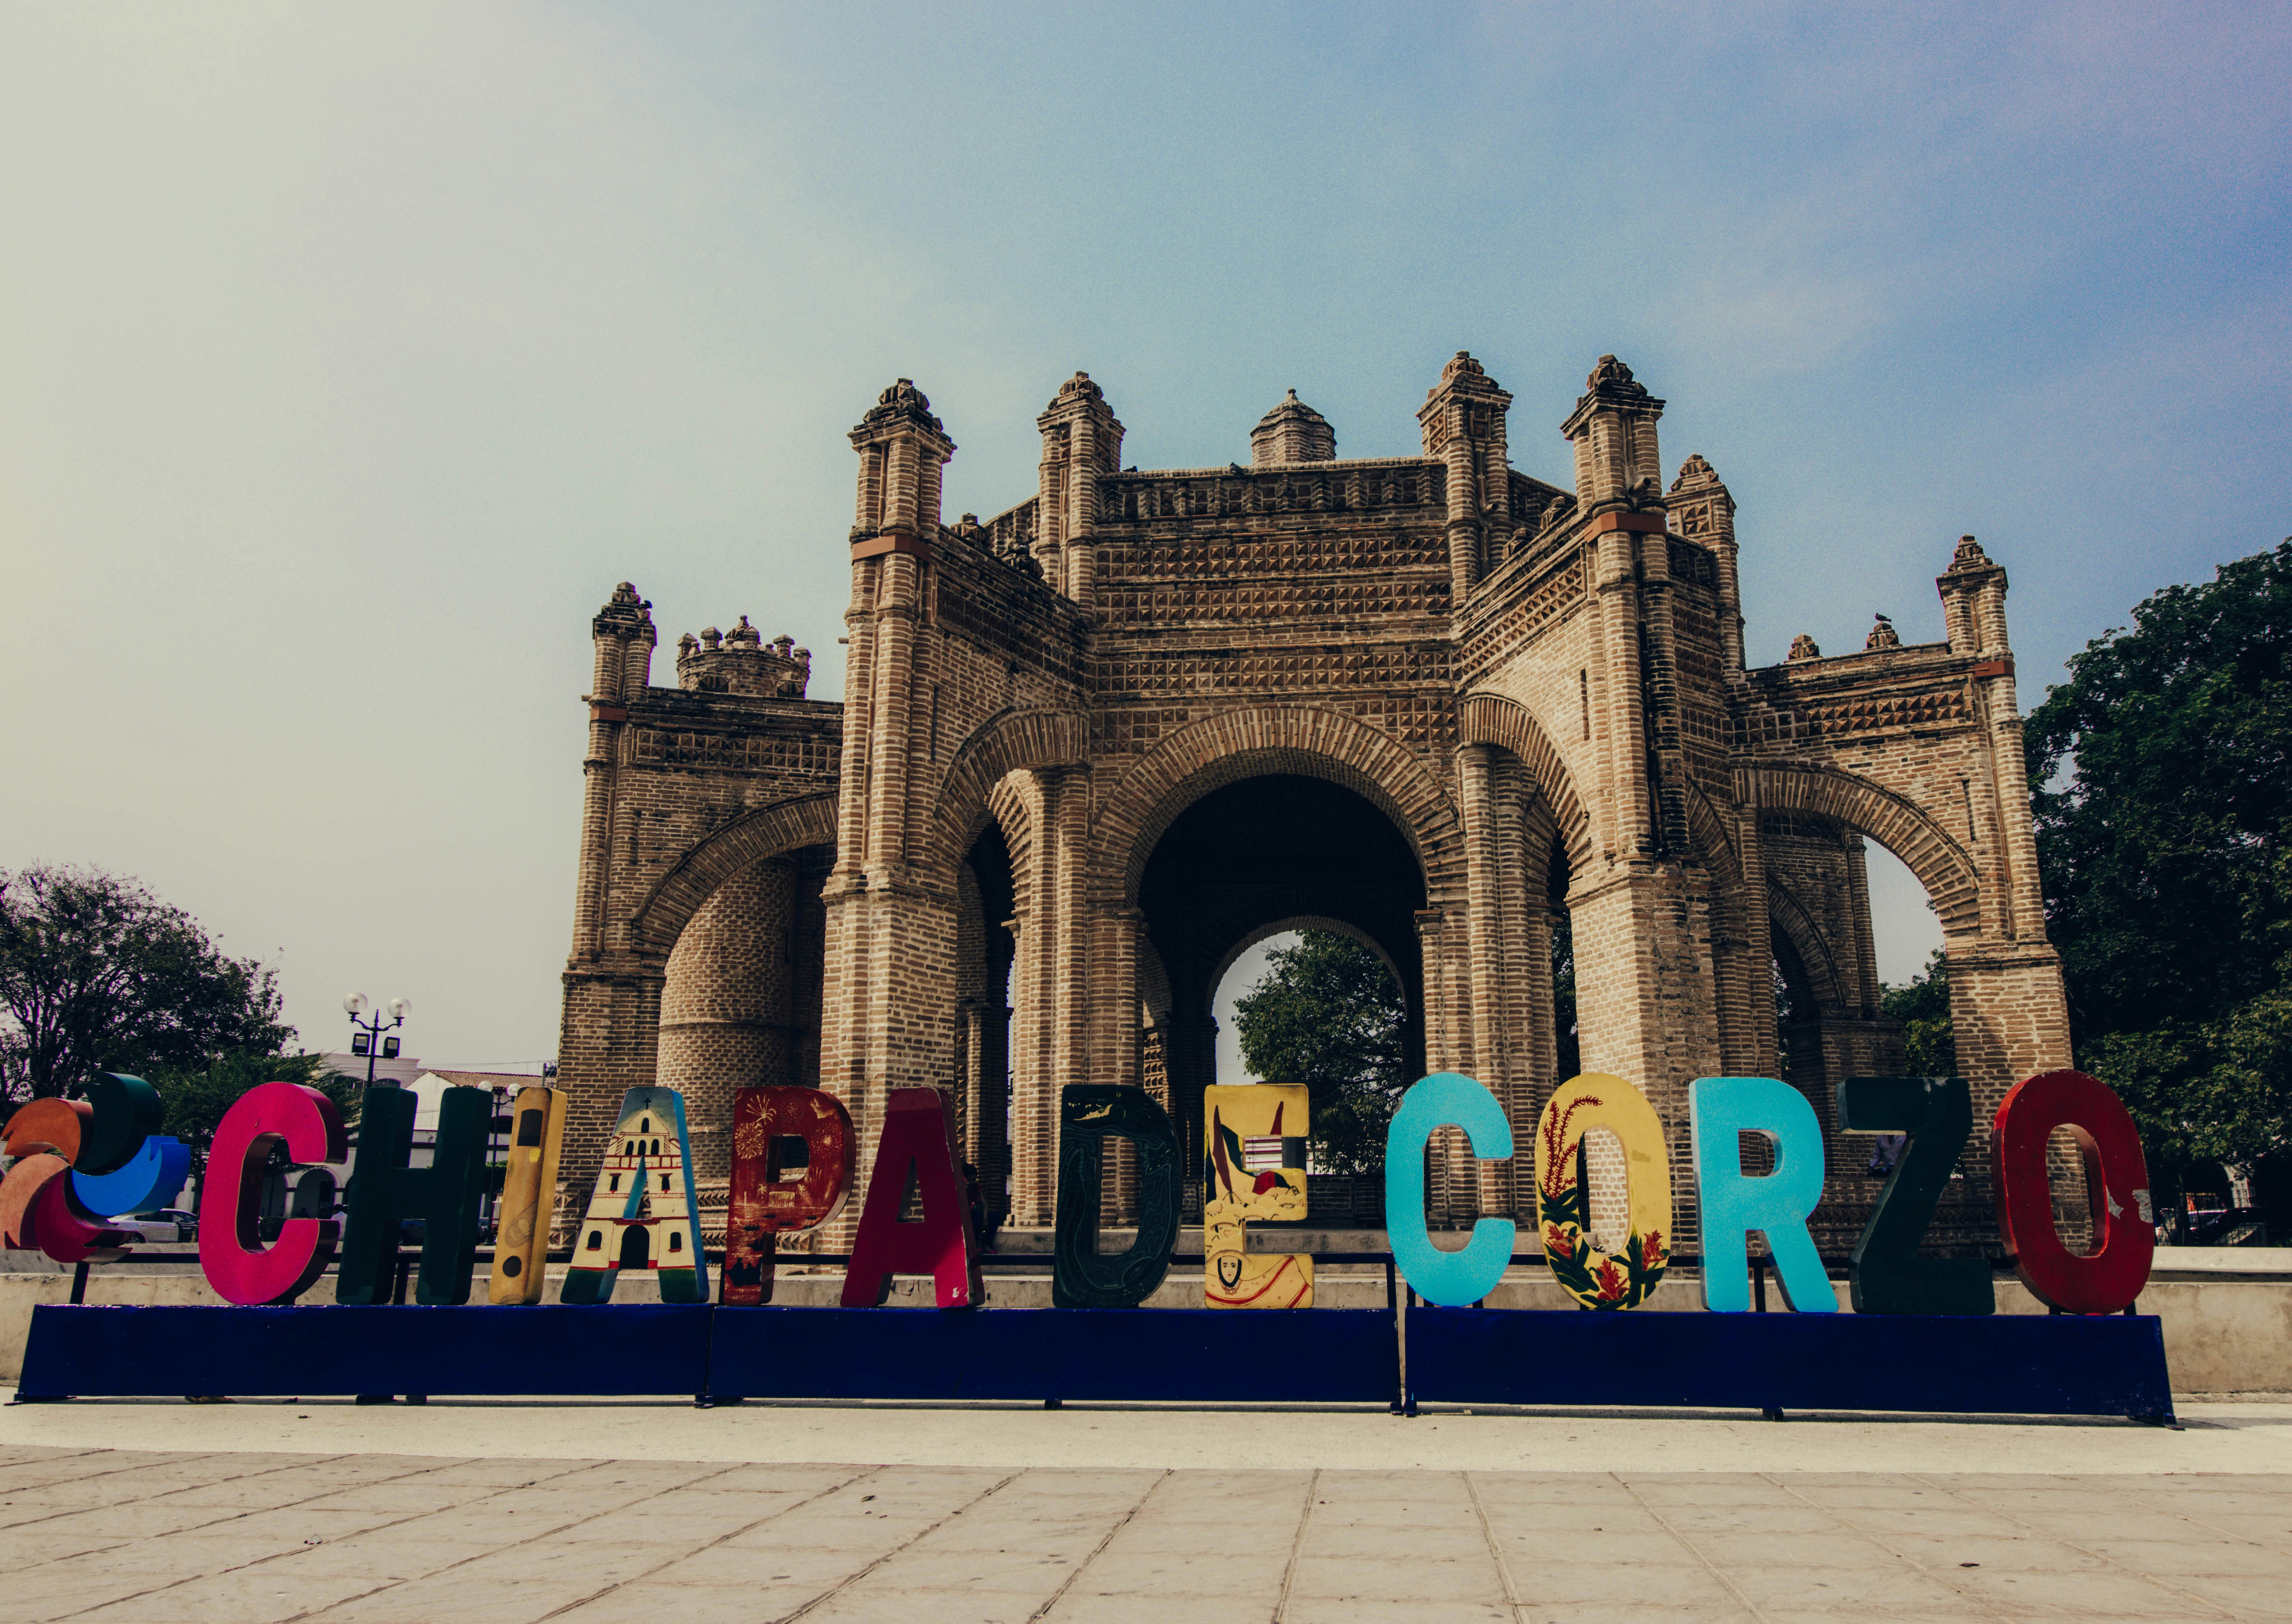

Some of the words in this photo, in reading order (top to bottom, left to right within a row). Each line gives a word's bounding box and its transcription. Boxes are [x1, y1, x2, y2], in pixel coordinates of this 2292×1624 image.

[199, 1082, 985, 1307] CHIAPA
[1052, 1084, 1314, 1309] DE
[1385, 1069, 2155, 1315] CORZO
